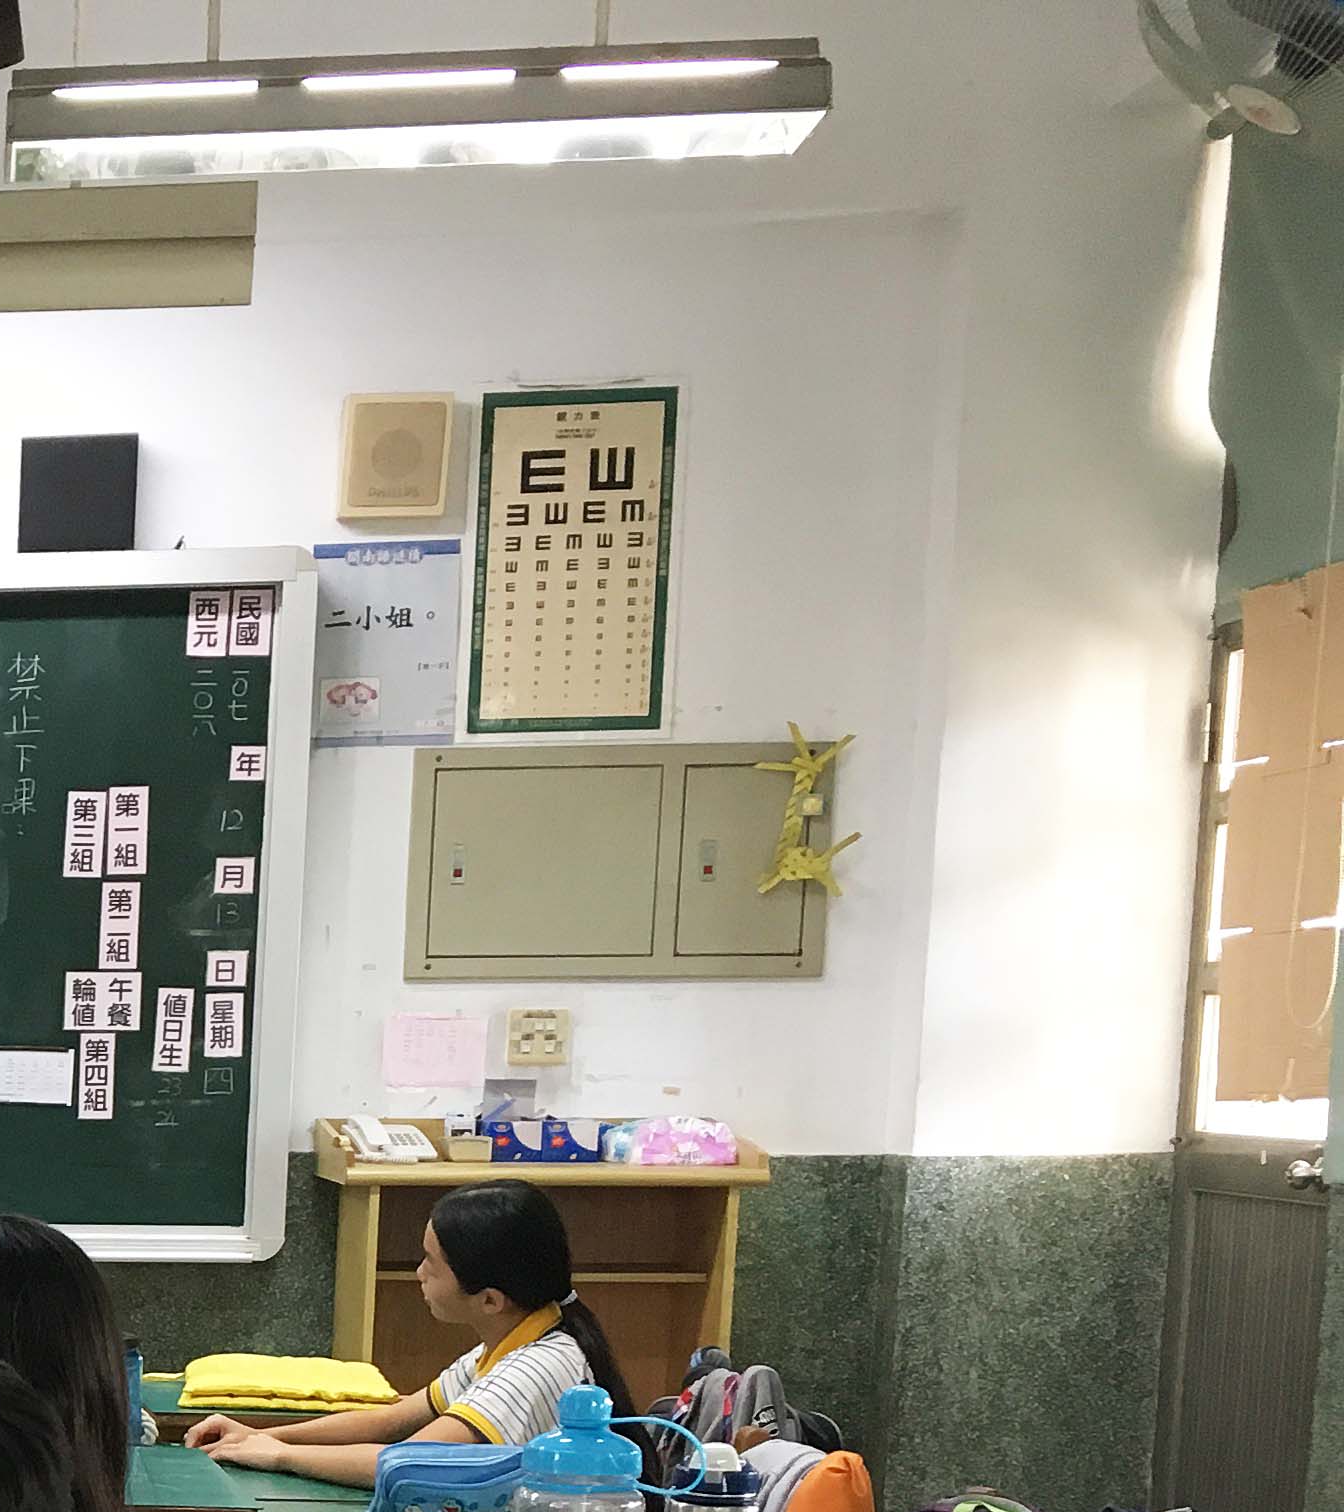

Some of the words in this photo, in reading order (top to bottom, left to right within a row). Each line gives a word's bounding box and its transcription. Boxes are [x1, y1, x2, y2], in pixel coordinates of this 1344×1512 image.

[194, 599, 220, 647] 西元
[235, 596, 262, 645] 民國
[235, 751, 261, 777] 年
[69, 798, 98, 874] 第三組
[113, 793, 141, 868] 第一組
[220, 808, 244, 833] 12
[220, 864, 245, 889] 月
[106, 888, 134, 965] 第二組
[215, 960, 235, 983] 日
[71, 978, 97, 1028] 輪值
[107, 978, 134, 1028] 午餐
[210, 1001, 236, 1050] 星期
[159, 994, 187, 1067] 值日生
[84, 1039, 109, 1114] 第四組
